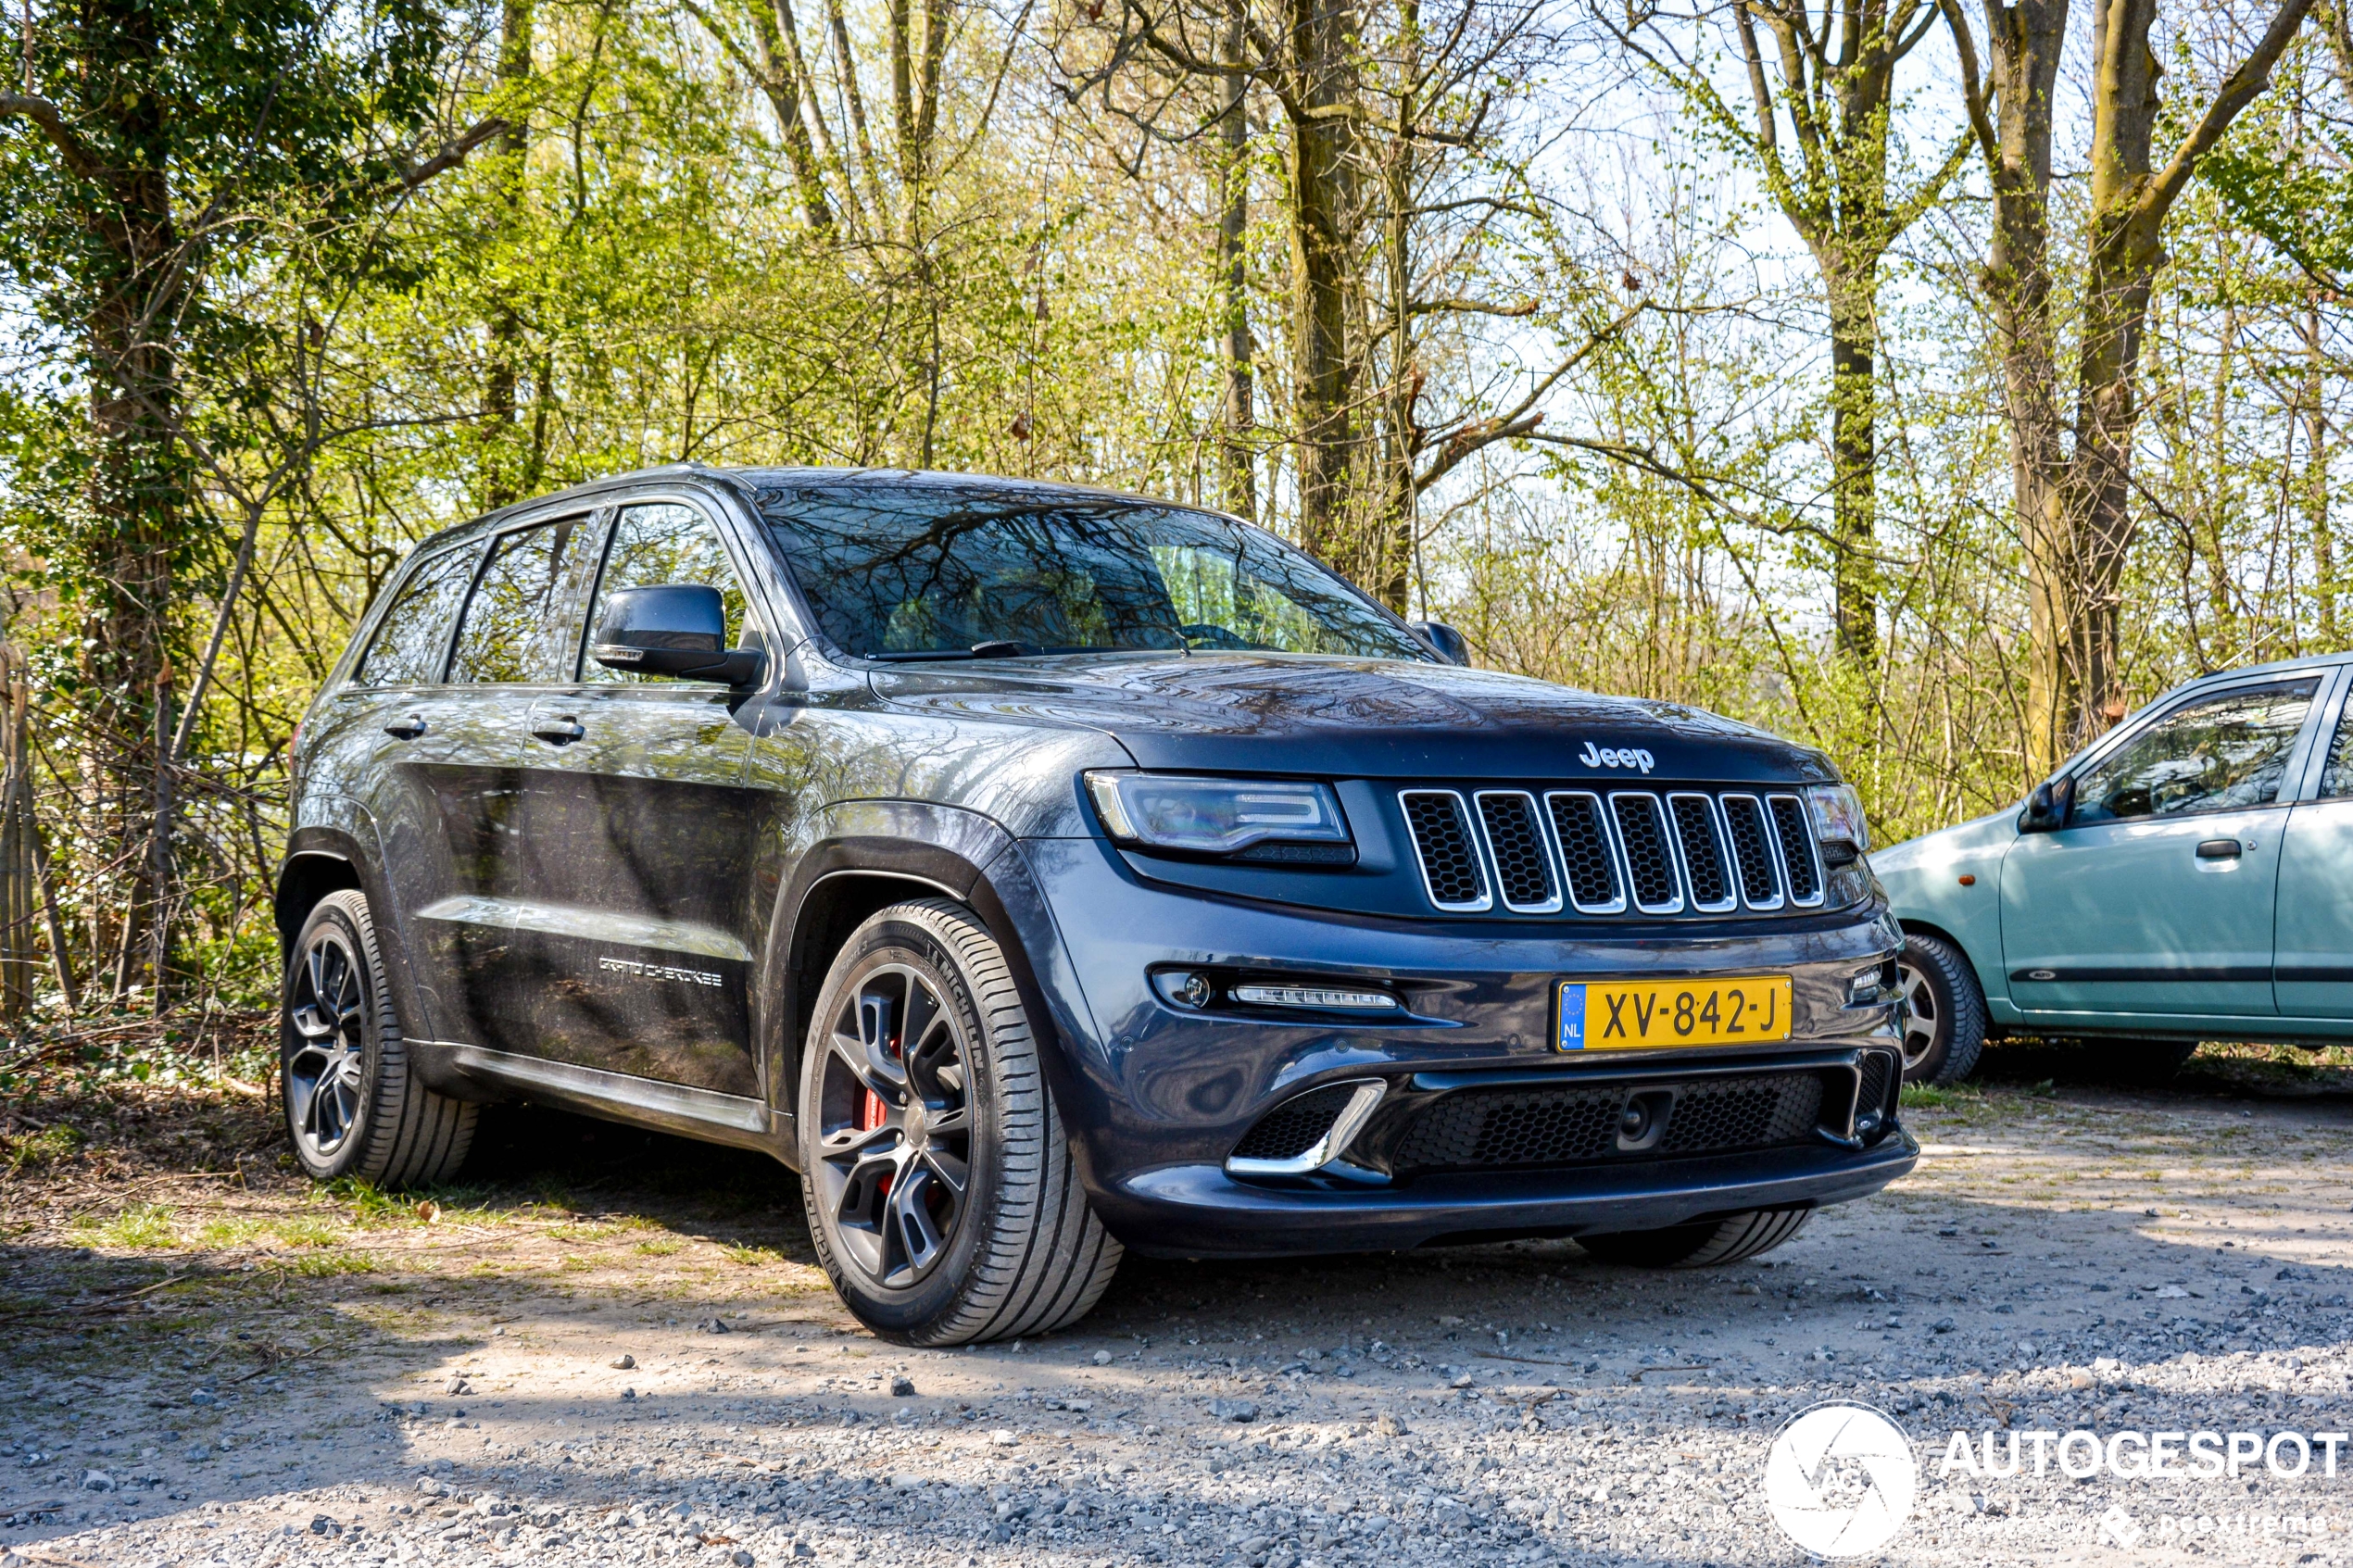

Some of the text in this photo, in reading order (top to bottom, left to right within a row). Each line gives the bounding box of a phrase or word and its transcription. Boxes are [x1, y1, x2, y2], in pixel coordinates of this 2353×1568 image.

[1579, 742, 1655, 774] Jeep
[840, 948, 861, 974] Sport
[938, 960, 984, 1070] MICHELIN
[1564, 1023, 1581, 1038] NL
[1603, 988, 1776, 1038] XV-842-J
[802, 1173, 842, 1282] MICHELIN
